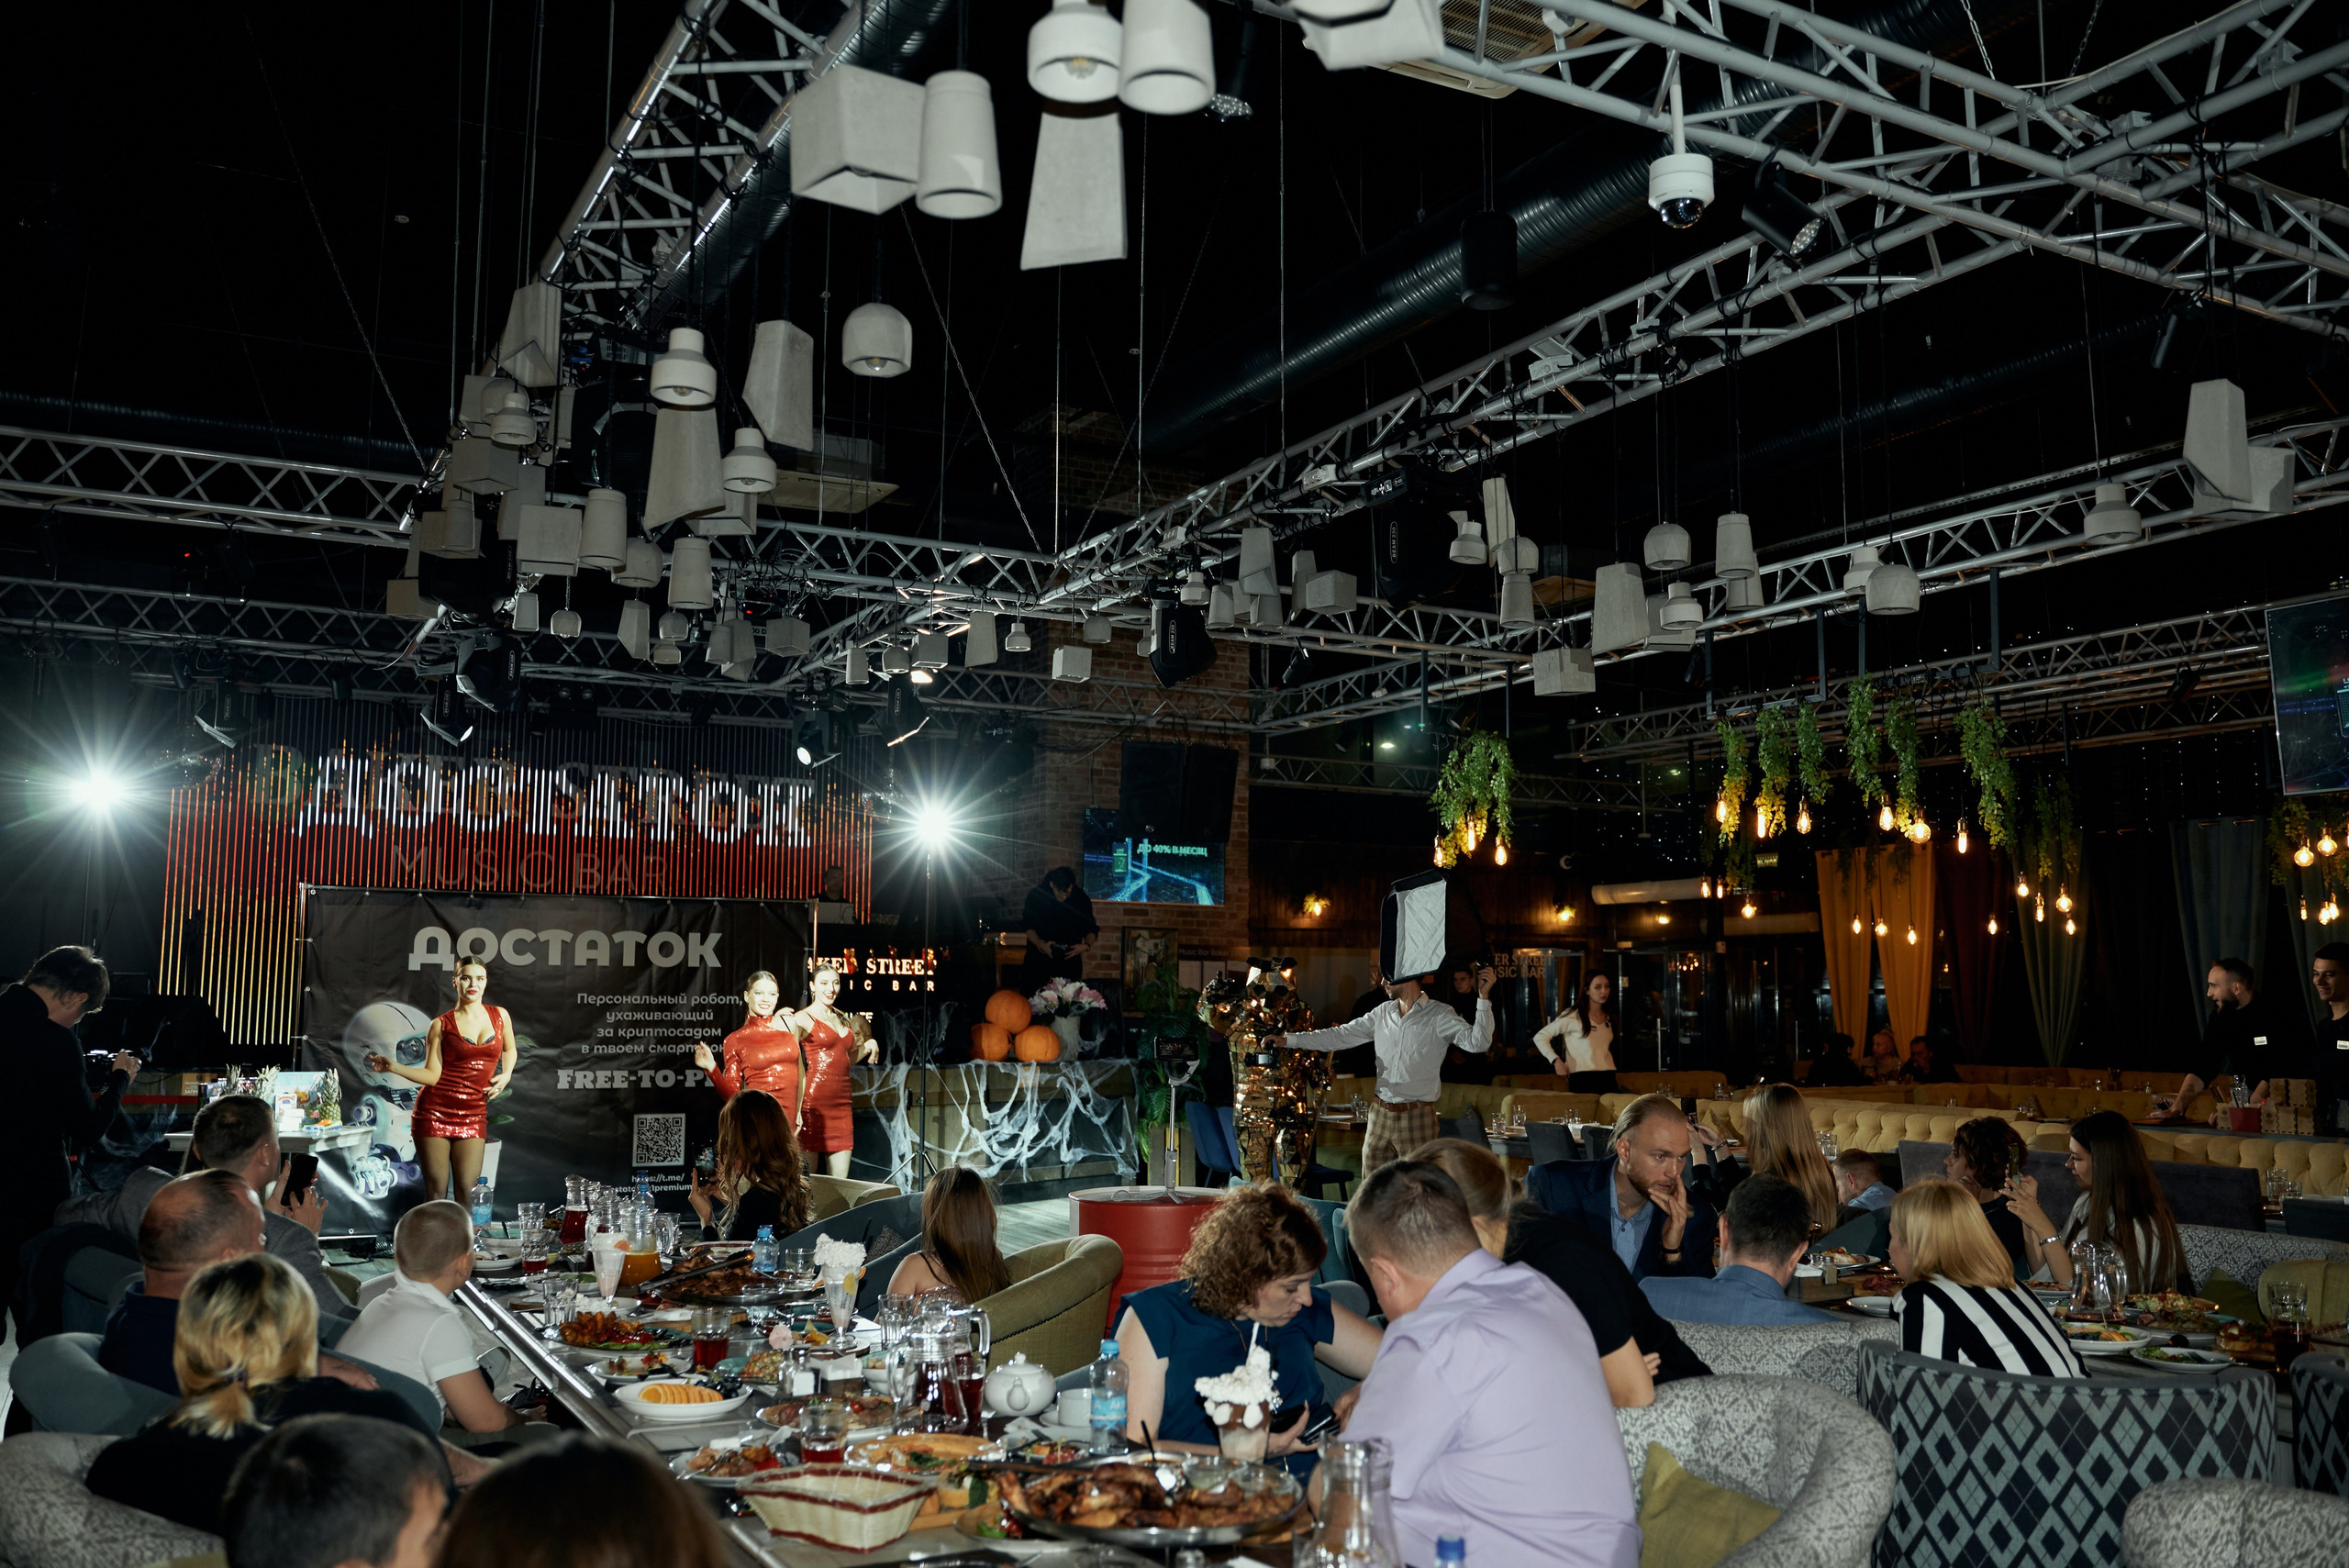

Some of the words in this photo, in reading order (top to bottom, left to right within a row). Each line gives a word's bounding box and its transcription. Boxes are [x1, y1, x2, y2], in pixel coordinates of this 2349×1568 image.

[250, 742, 522, 818] BAKER
[554, 761, 817, 833] STREET
[391, 844, 554, 889] MUSIC
[574, 851, 668, 893] BAR
[408, 926, 723, 972] ДОСТАТОК
[577, 992, 687, 1007] Персональный
[691, 993, 743, 1007] робот,
[606, 1009, 714, 1023] ухаживающий
[596, 1028, 614, 1038] за
[618, 1028, 722, 1040] криптосадом
[581, 1044, 590, 1054] в
[594, 1044, 644, 1054] твоем
